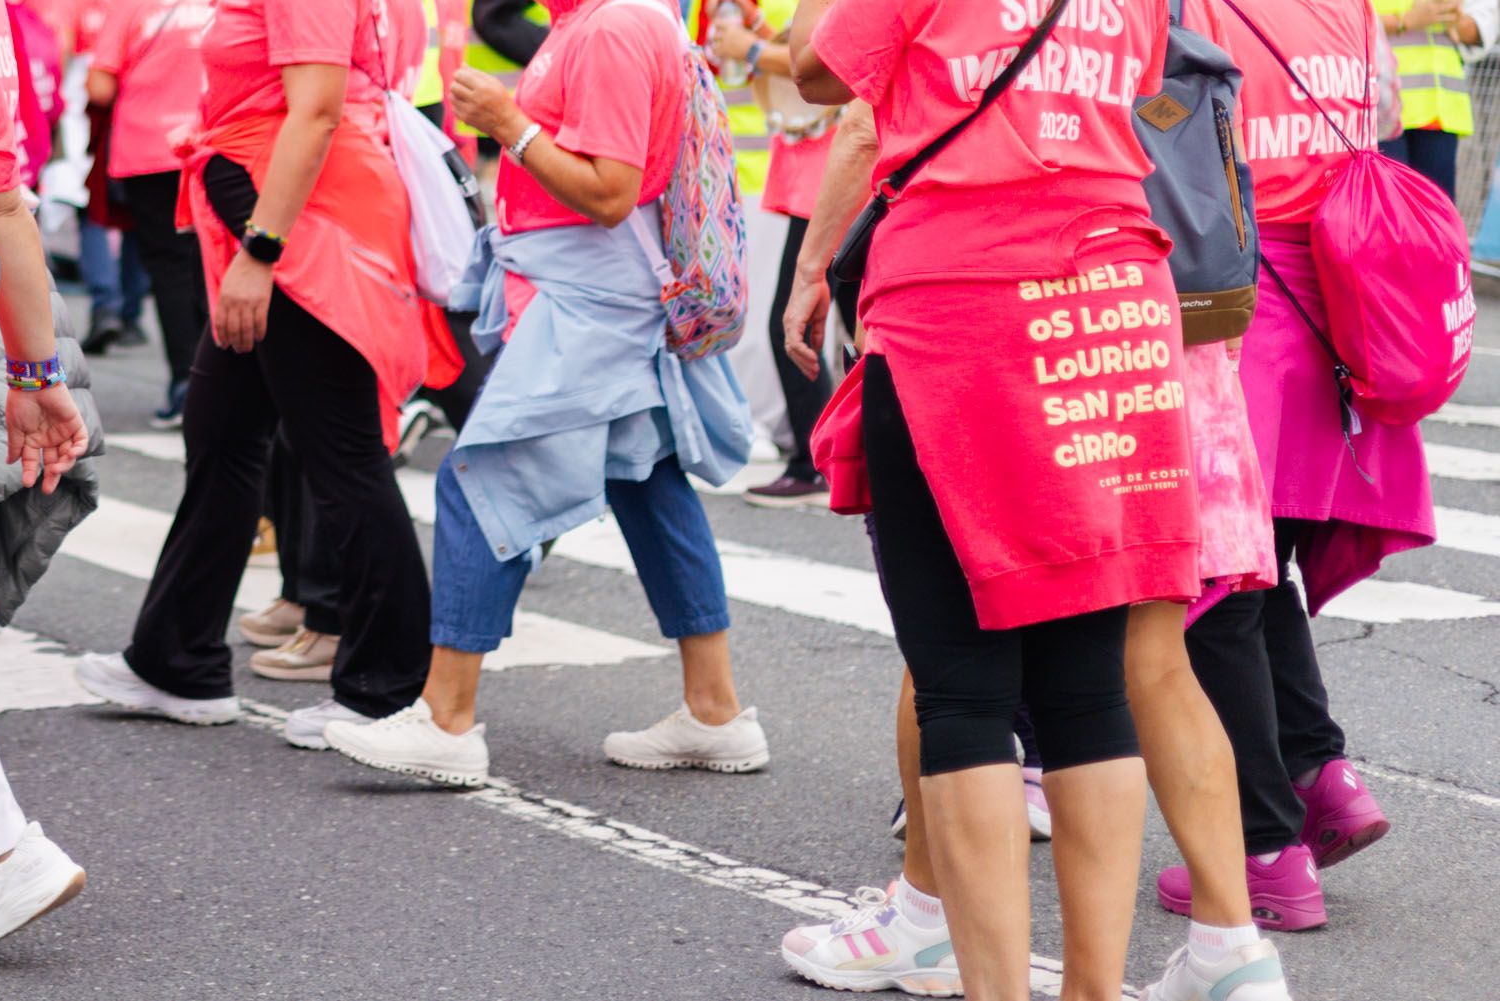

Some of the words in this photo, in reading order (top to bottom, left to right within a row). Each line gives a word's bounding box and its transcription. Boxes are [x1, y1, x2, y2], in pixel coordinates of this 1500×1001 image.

[1039, 112, 1081, 142] 2026
[1028, 310, 1075, 342] oS
[1079, 299, 1172, 335] LoBOs
[1035, 340, 1171, 385] LoURidO
[1043, 390, 1109, 426] SaN
[1055, 431, 1137, 468] ciRRo
[1127, 472, 1143, 482] DE
